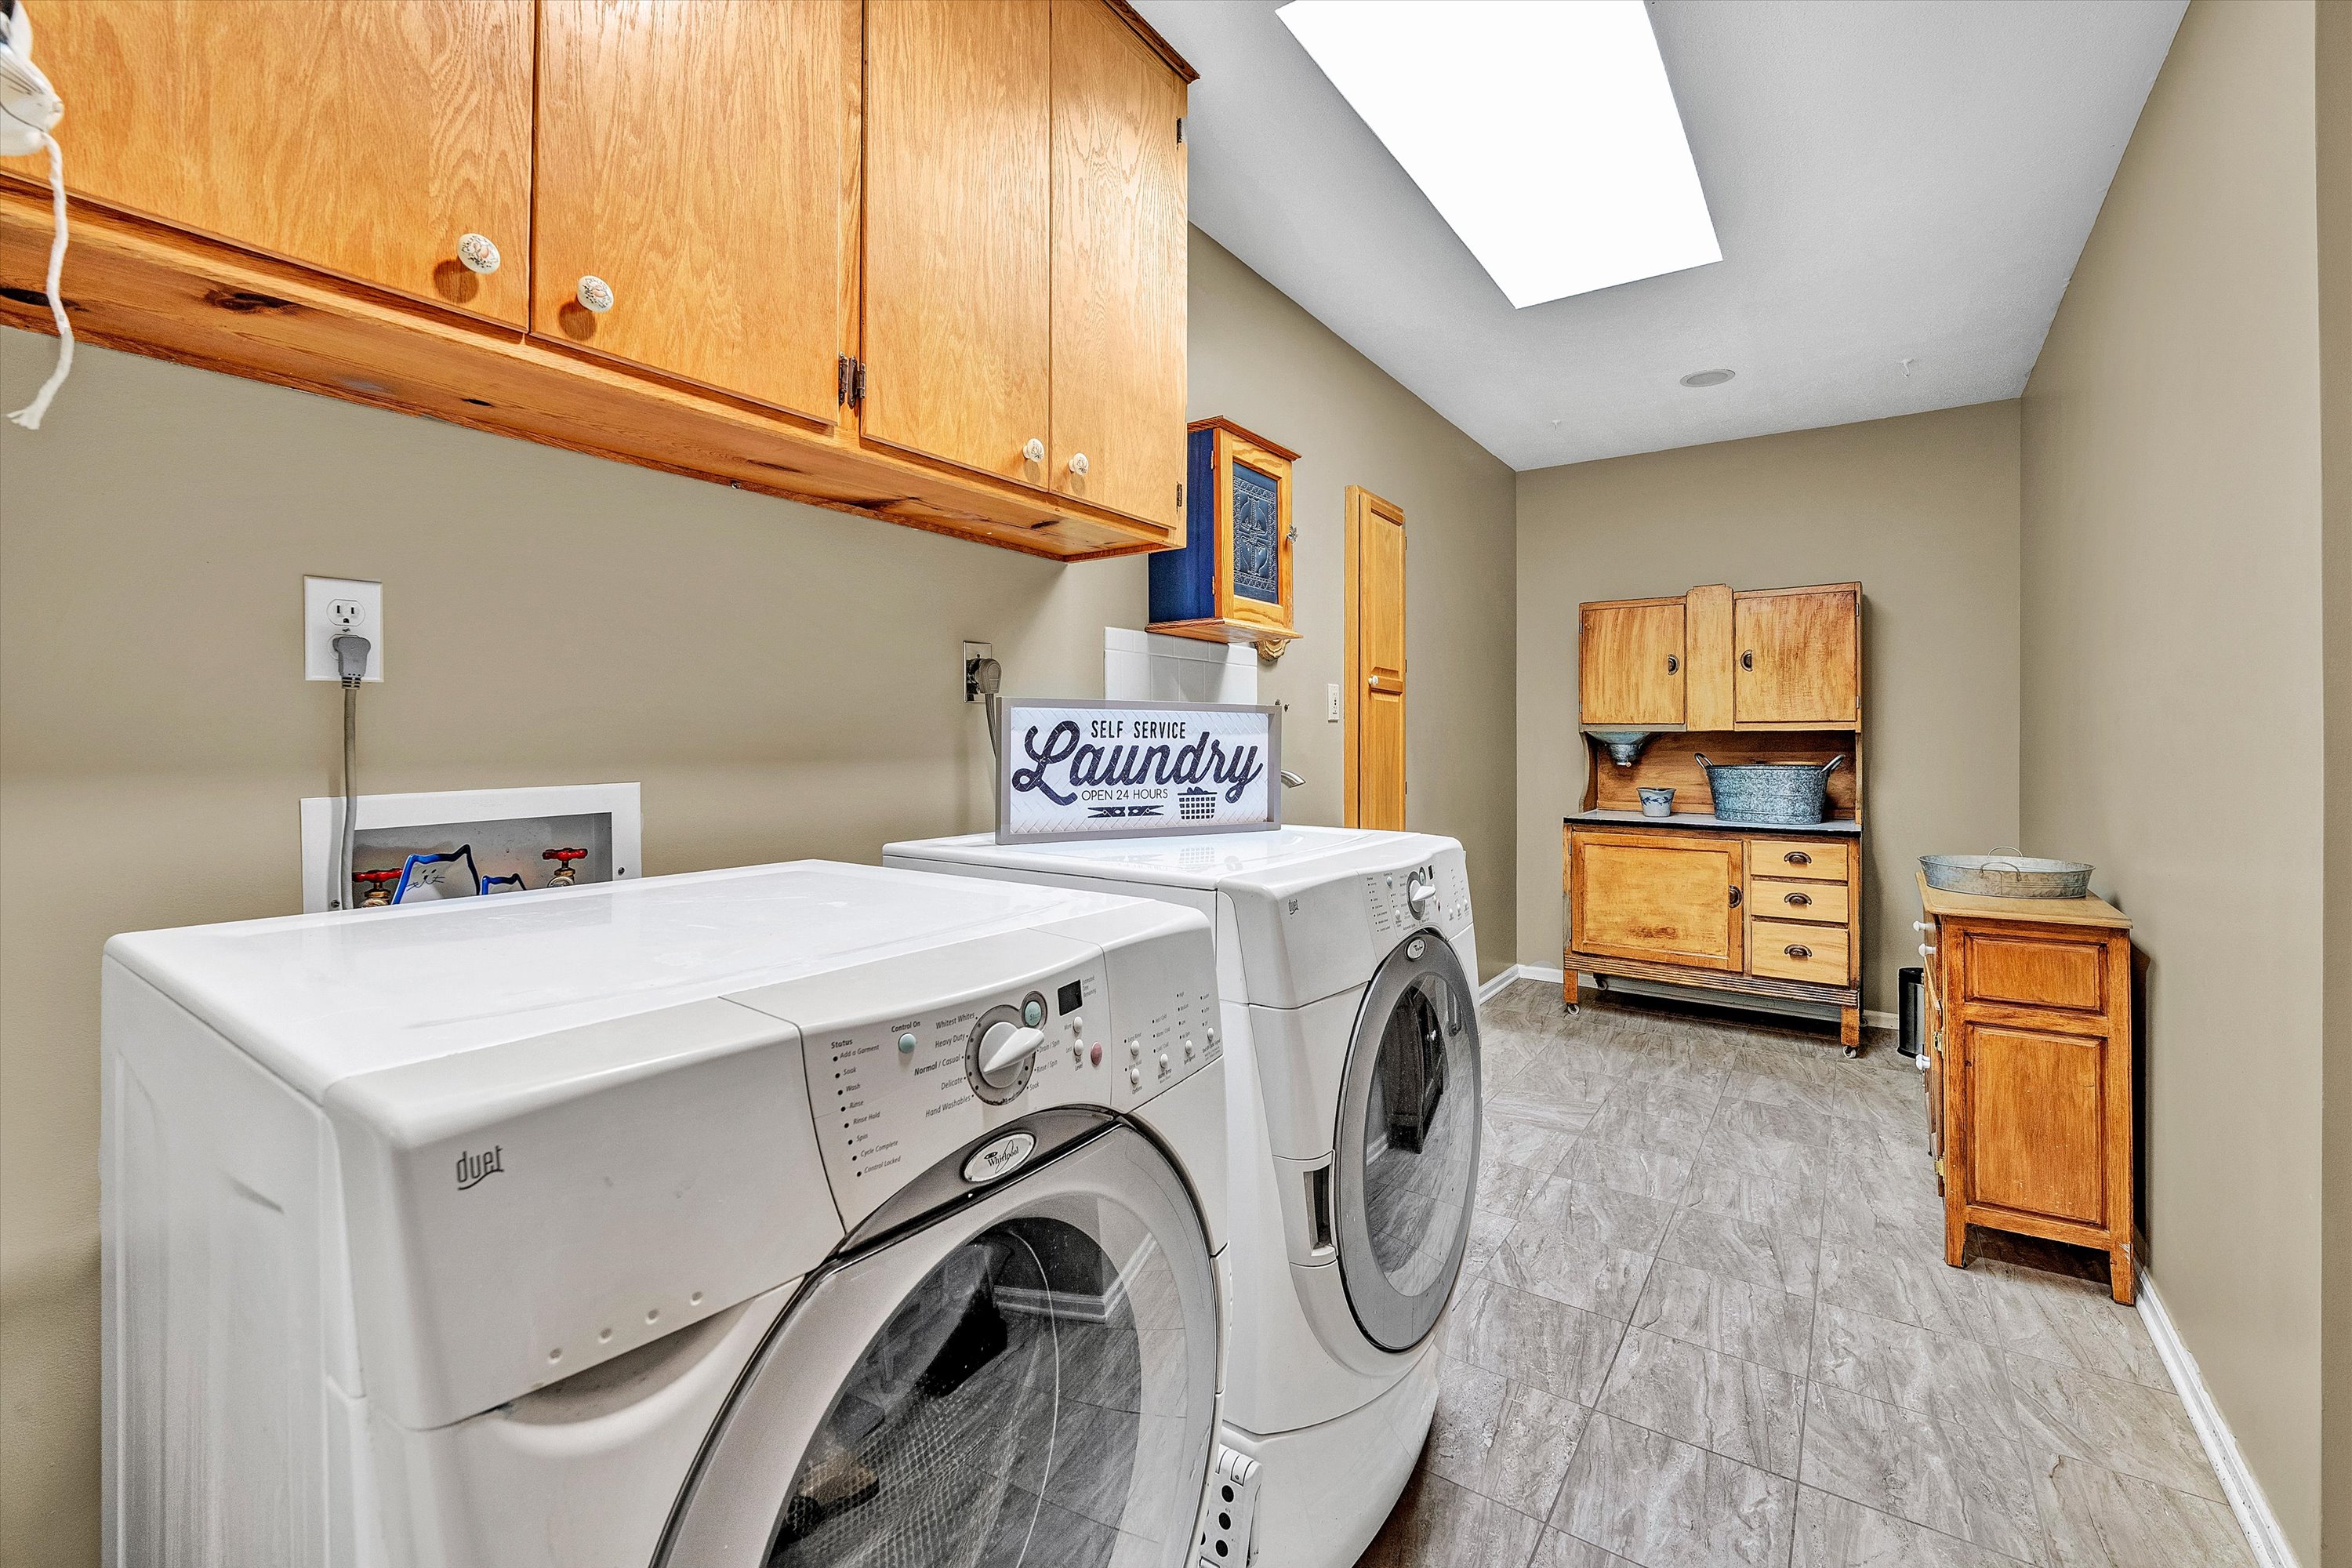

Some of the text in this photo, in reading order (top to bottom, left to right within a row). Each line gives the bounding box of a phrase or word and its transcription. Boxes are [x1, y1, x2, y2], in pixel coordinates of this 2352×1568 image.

[1091, 720, 1186, 739] SELF SERVICE
[1011, 720, 1263, 806] Laundry
[1081, 788, 1168, 801] OPEN 24 HOURS
[891, 1021, 912, 1033] Control
[935, 1012, 975, 1029] Whitest Whites
[831, 1039, 853, 1049] Status
[935, 1033, 965, 1048] Heavy Duty
[857, 1044, 880, 1054] Garment
[843, 1066, 856, 1076] Soak
[914, 1061, 938, 1076] Normal
[942, 1054, 960, 1066] Casual
[846, 1083, 861, 1092] Wash
[941, 1077, 963, 1090] Delicate
[925, 1095, 971, 1118] Hand Washables
[853, 1111, 880, 1124] Rinse Hold
[861, 1141, 898, 1157] Cycle Complete
[987, 1145, 1019, 1167] Whirlpool
[456, 1145, 503, 1185] duet
[864, 1156, 901, 1173] Control Locked
